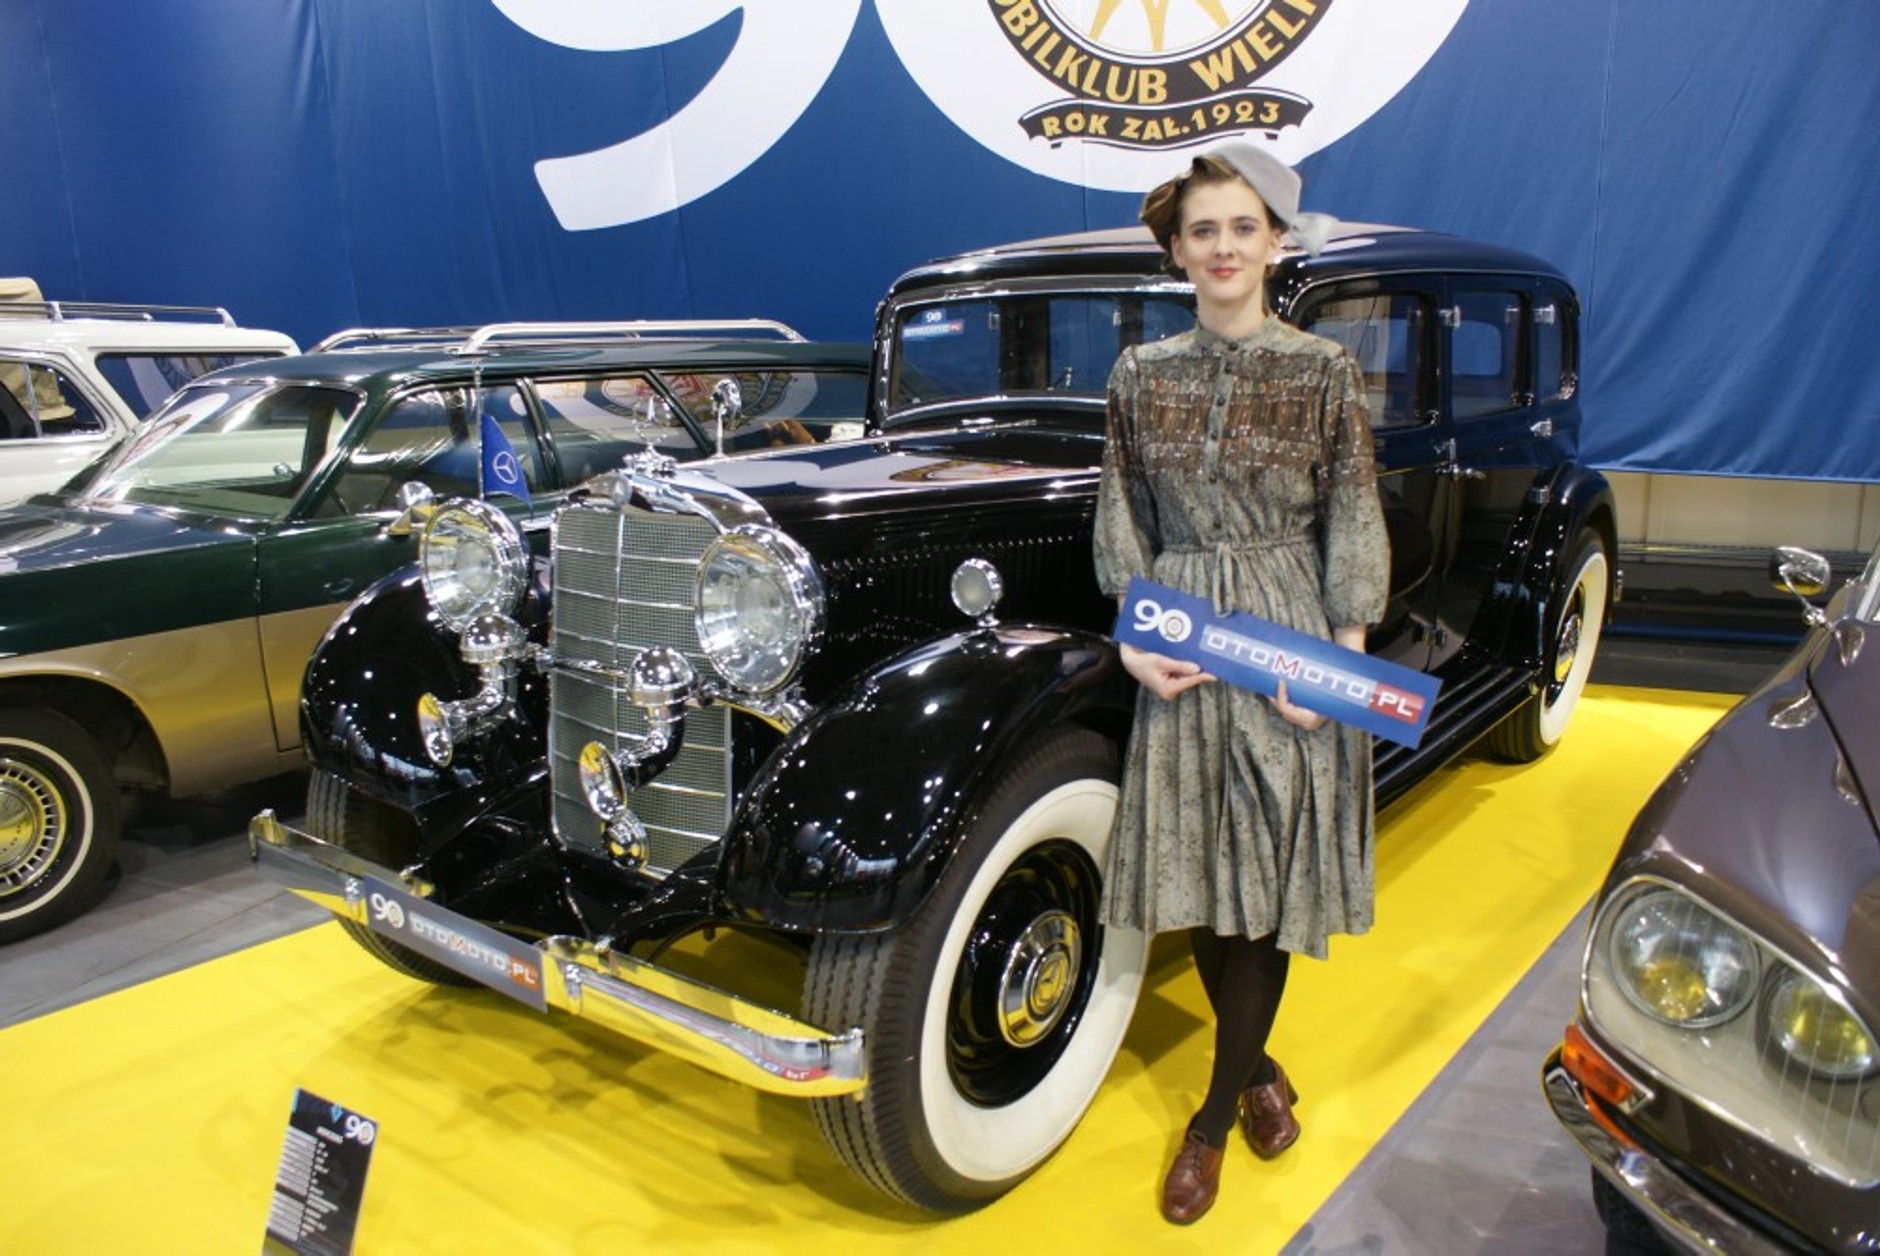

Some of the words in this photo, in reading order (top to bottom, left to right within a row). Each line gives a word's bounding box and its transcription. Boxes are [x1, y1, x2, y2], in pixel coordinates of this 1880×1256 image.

[995, 0, 1168, 105] BILKLUB
[1042, 112, 1109, 138] ROK
[1133, 599, 1193, 643] 90
[1207, 632, 1414, 716] OTOMOTO.PL
[370, 893, 405, 929] 90
[345, 1115, 374, 1145] 90
